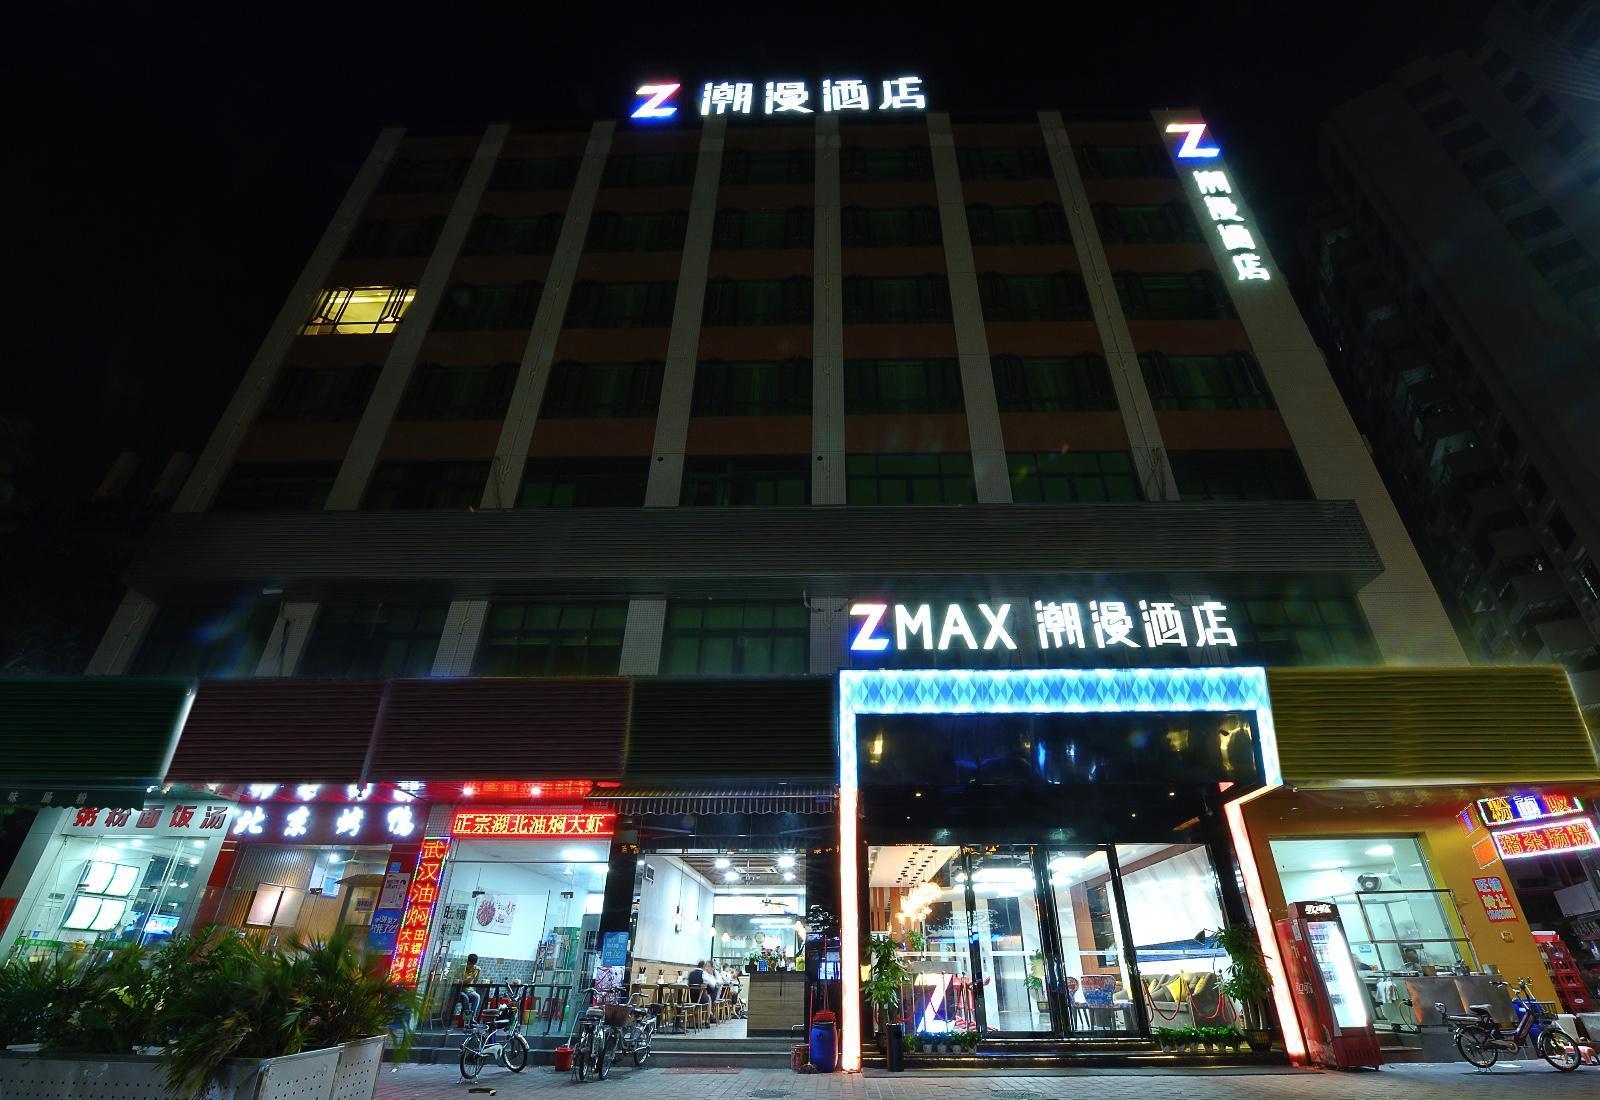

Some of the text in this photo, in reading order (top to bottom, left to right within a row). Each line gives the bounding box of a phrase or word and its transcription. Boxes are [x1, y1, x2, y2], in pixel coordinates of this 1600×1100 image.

[631, 77, 926, 117] Z 潮漫酒店
[1165, 124, 1220, 157] Z
[849, 599, 1238, 650] ZMAX 潮漫酒店
[72, 804, 228, 830] 粥粉面饭汤
[233, 806, 415, 837] 北京烤鸭
[454, 814, 604, 833] 正宗湖北油焖大虾
[405, 841, 447, 926] 武汉油焖
